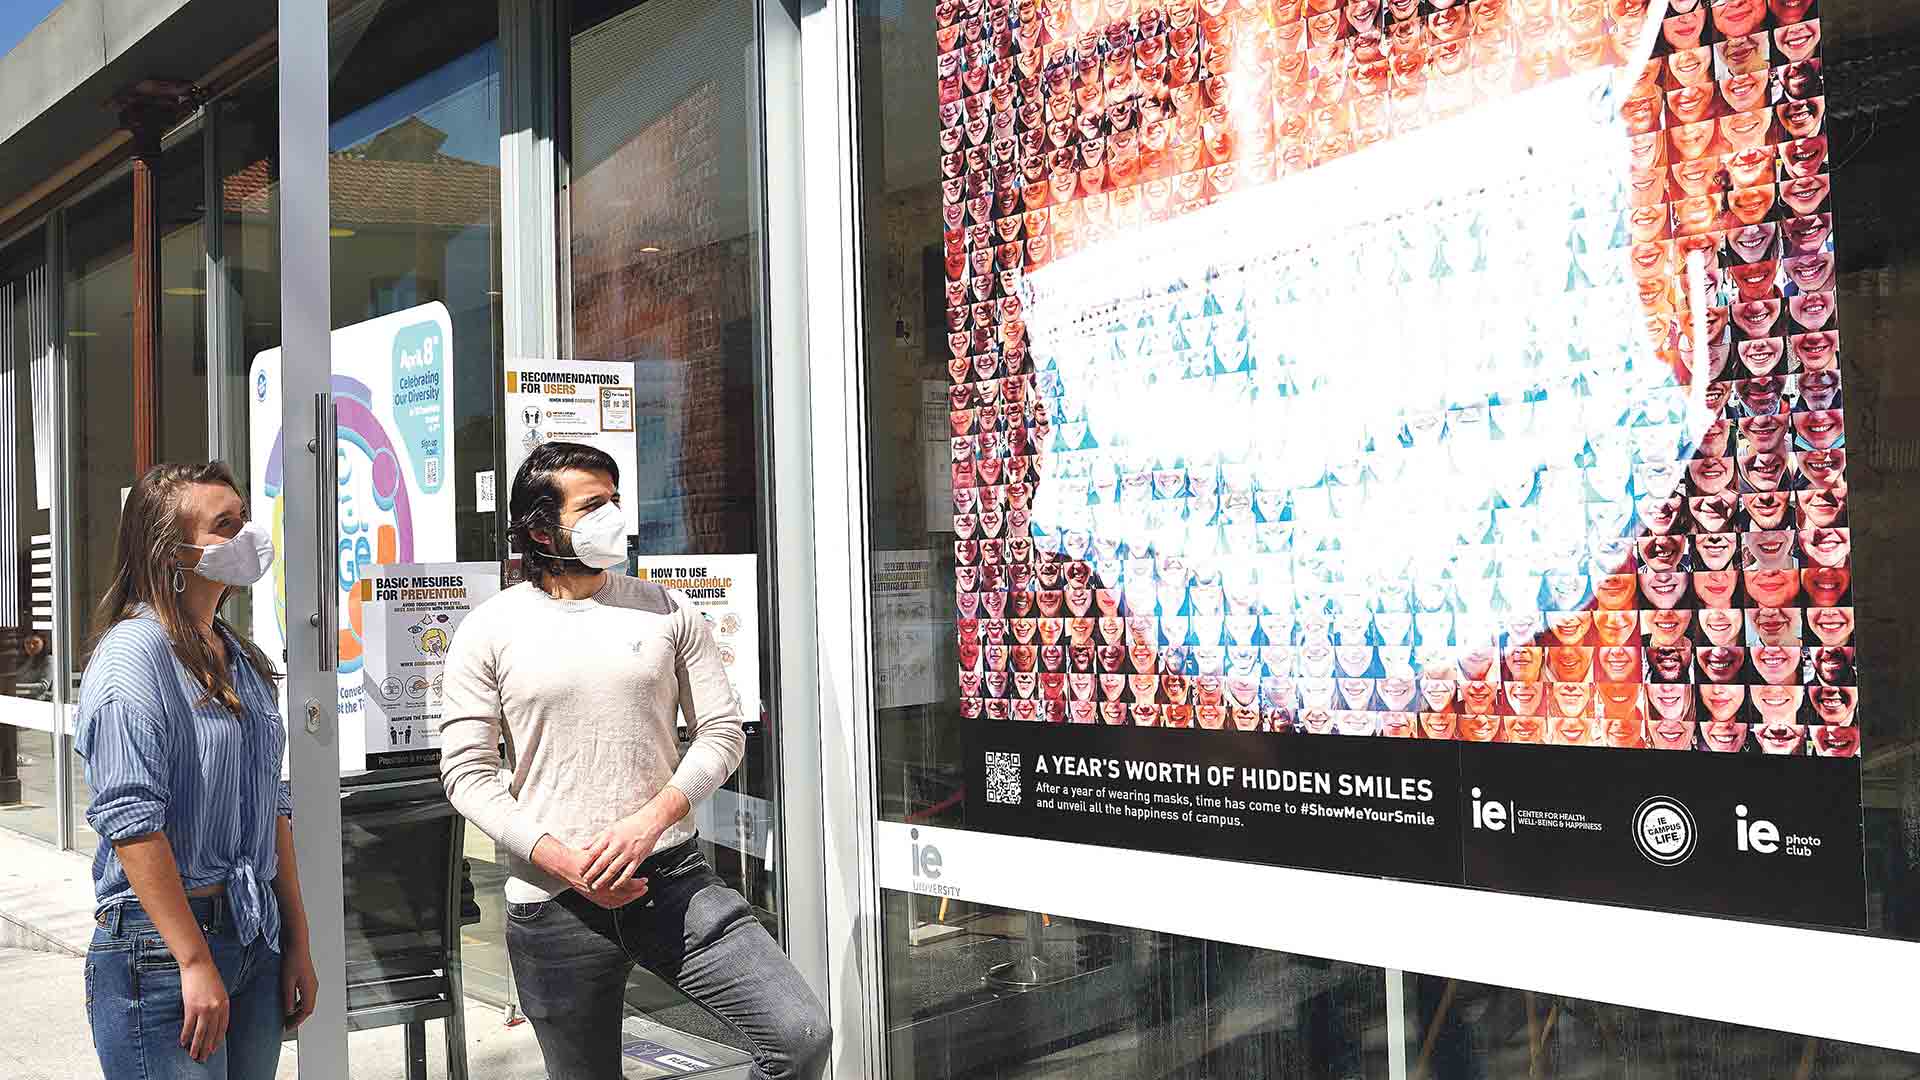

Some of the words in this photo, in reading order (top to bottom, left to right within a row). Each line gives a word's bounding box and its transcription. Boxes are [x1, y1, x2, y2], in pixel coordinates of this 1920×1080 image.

[399, 370, 439, 390] Celebrating
[521, 371, 620, 385] RECOMMENDATIONS
[394, 393, 407, 406] Our
[408, 385, 439, 402] Diversity
[521, 383, 541, 394] FOR
[544, 384, 576, 395] USERS
[651, 568, 672, 578] HOW
[675, 568, 686, 577] TO
[689, 567, 707, 577] USE
[376, 577, 408, 588] BASIC
[411, 576, 463, 588] MESURES
[376, 590, 398, 601] FOR
[401, 588, 466, 600] PREVENTION
[685, 588, 726, 598] SANITISE
[345, 701, 357, 714] the
[1035, 755, 1048, 773] A
[1052, 755, 1120, 779] YEAR'S
[1125, 760, 1200, 785] WORTH
[1207, 766, 1235, 787] OF
[1242, 767, 1331, 795] HIDDEN
[1338, 774, 1433, 801] SMILES
[1036, 782, 1060, 795] After
[1062, 786, 1069, 795] a
[1071, 786, 1093, 802] year
[1096, 786, 1106, 798] of
[1108, 788, 1150, 804] wearing
[1154, 792, 1193, 807] masks,
[1196, 794, 1221, 808] time
[1225, 797, 1246, 810] has
[1249, 801, 1281, 813] come
[1285, 803, 1297, 814] to
[1300, 803, 1435, 825] #ShowMeYourSmile
[1471, 786, 1507, 831] ie
[1036, 798, 1054, 809] and
[1057, 800, 1087, 812] unveil
[1089, 802, 1102, 813] all
[1105, 803, 1122, 815] the
[1124, 805, 1179, 821] happiness
[1182, 810, 1193, 822] of
[1196, 813, 1244, 828] campus.
[1517, 810, 1543, 819] CENTER
[1544, 812, 1558, 820] FOR
[1560, 813, 1585, 822] HEALTH
[1518, 817, 1558, 828] WELL-BEING
[1565, 822, 1602, 831] HAPPINESS
[1657, 816, 1667, 825] IE
[1648, 822, 1681, 835] CAMPUS
[1735, 804, 1780, 853] ie
[1655, 832, 1679, 845] LIFE
[1785, 834, 1821, 847] photo
[910, 827, 943, 879] ie
[1785, 845, 1812, 857] club
[913, 880, 961, 897] UNIVERSITY
